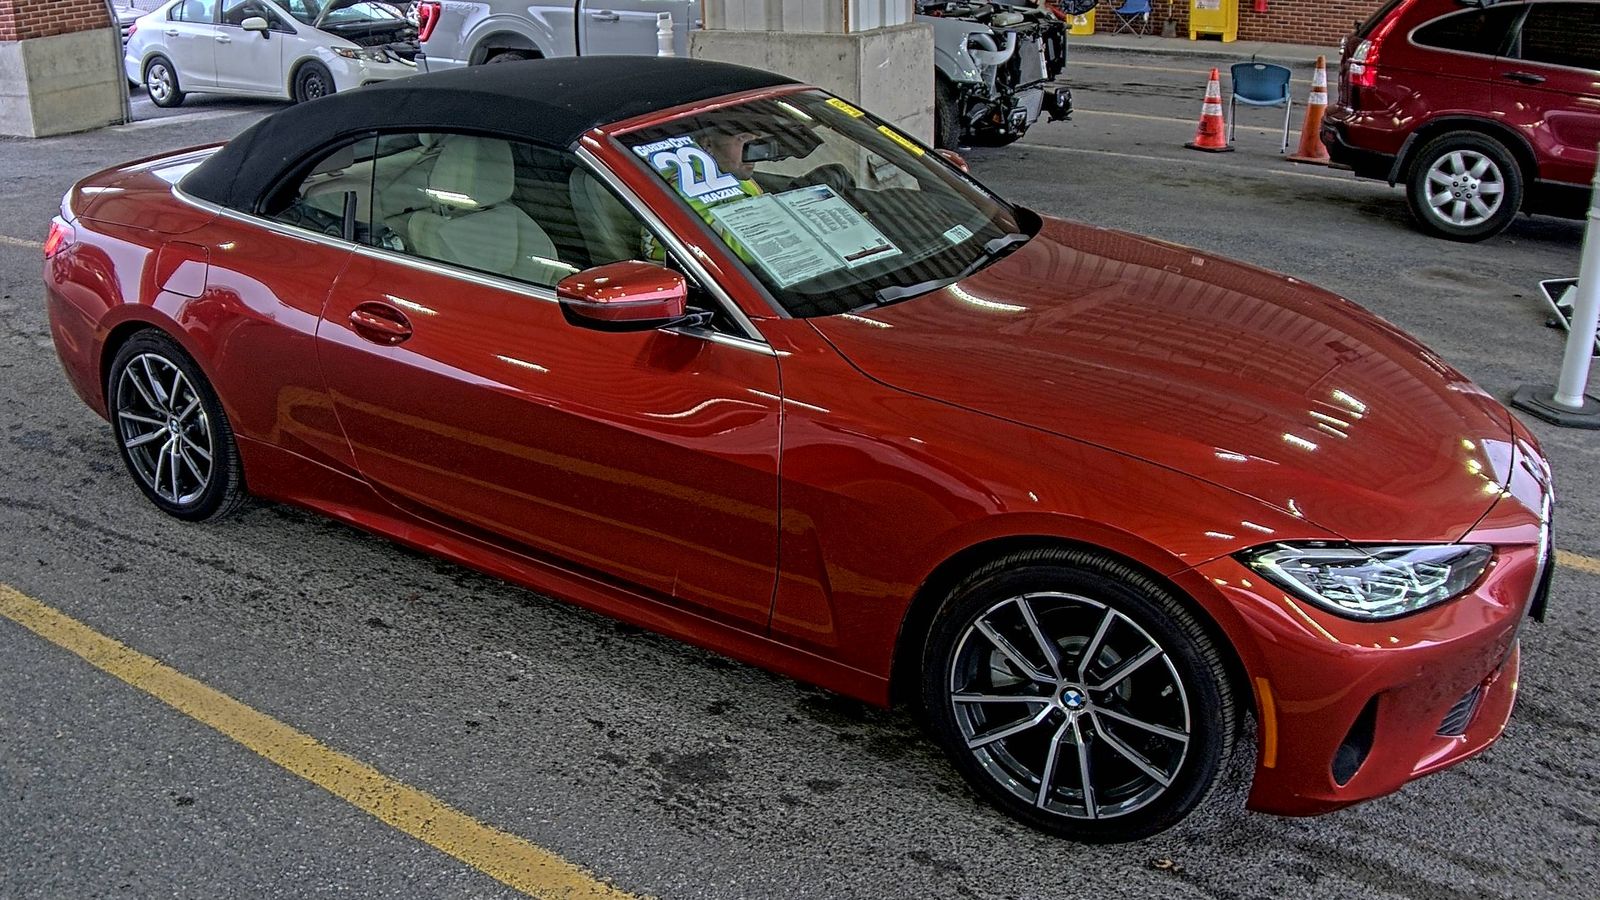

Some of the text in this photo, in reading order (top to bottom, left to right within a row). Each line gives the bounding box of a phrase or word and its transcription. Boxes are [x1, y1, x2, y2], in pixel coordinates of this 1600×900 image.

[670, 136, 694, 148] CITY
[653, 147, 739, 197] 22
[699, 187, 744, 204] MAZDA
